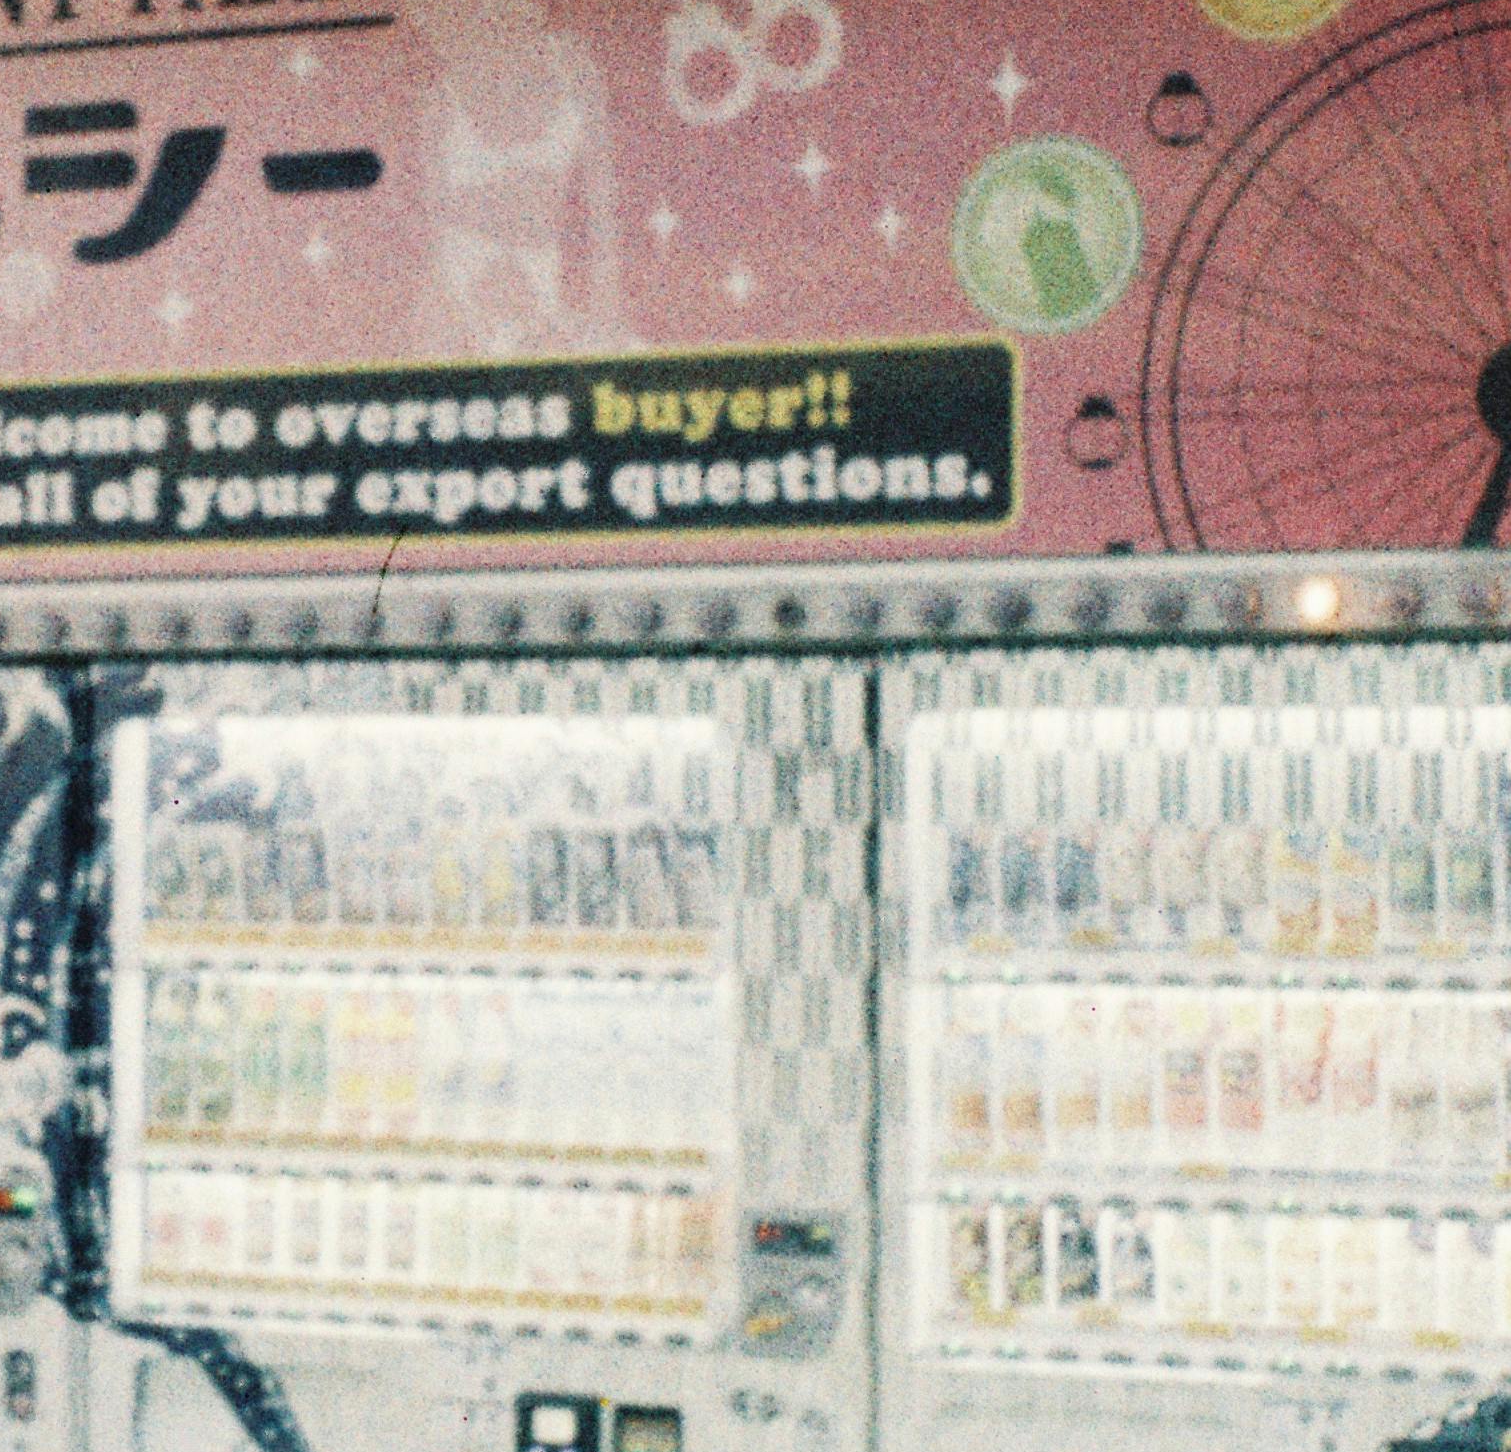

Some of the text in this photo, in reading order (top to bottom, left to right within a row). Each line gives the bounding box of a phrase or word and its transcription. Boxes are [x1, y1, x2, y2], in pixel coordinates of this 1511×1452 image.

[186, 399, 258, 450] to
[274, 393, 573, 448] overseas
[591, 368, 854, 444] buyer!!
[90, 465, 163, 524] of
[175, 470, 339, 532] your
[353, 455, 591, 525] export
[608, 443, 993, 521] questions.
